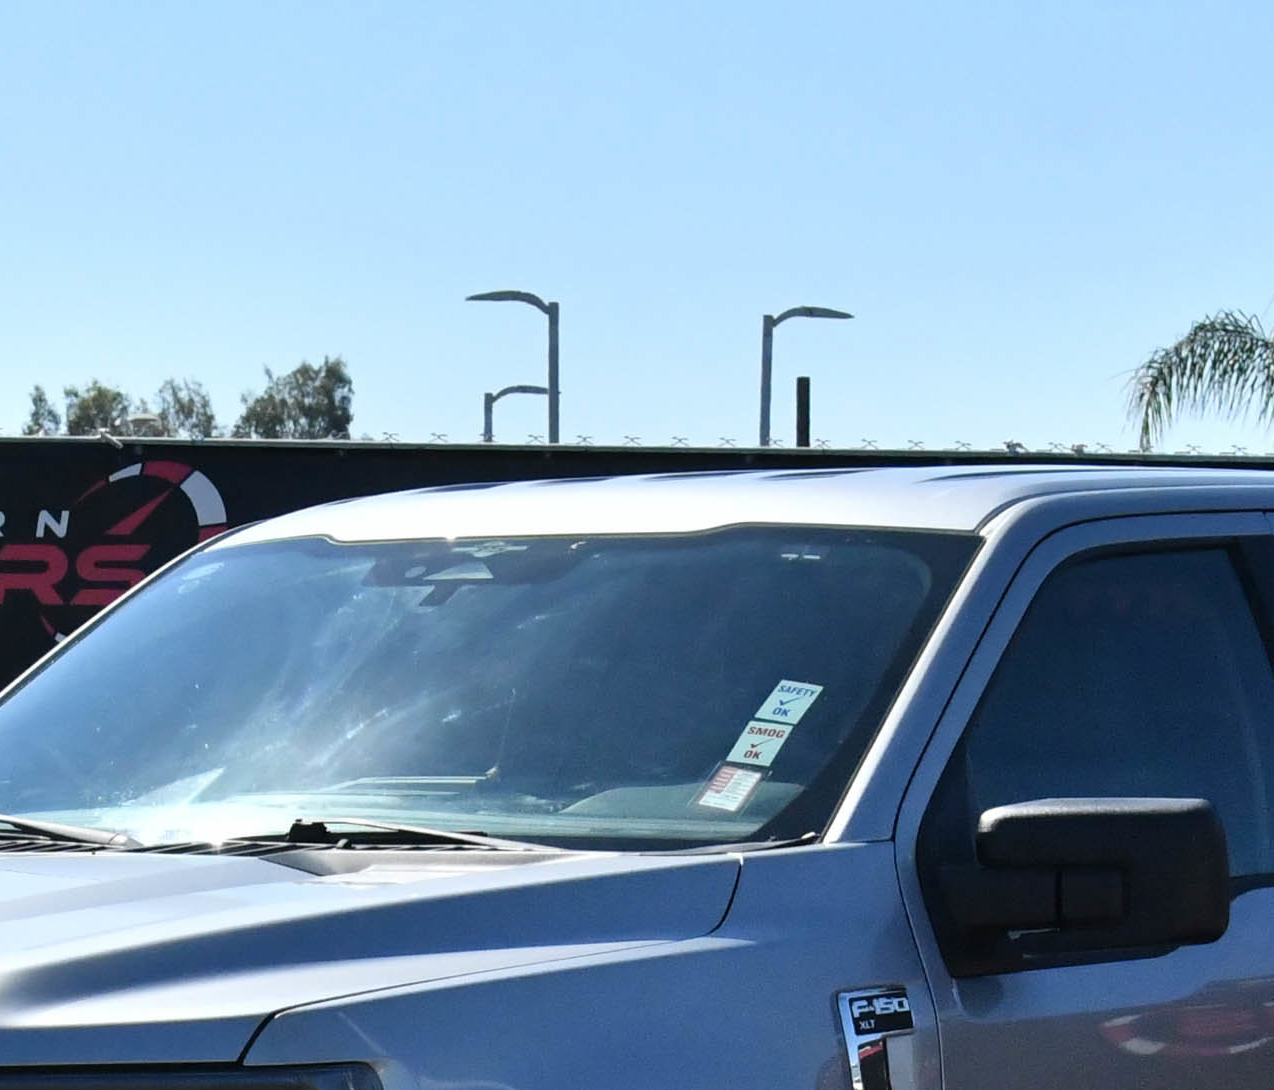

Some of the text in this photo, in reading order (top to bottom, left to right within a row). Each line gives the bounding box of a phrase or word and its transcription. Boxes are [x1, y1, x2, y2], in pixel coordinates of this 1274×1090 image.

[777, 685, 818, 697] SAFETY
[772, 707, 791, 717] OK
[747, 726, 786, 739] SMOG
[743, 750, 762, 760] OK
[852, 997, 910, 1018] F-150
[858, 1019, 875, 1030] XLT
